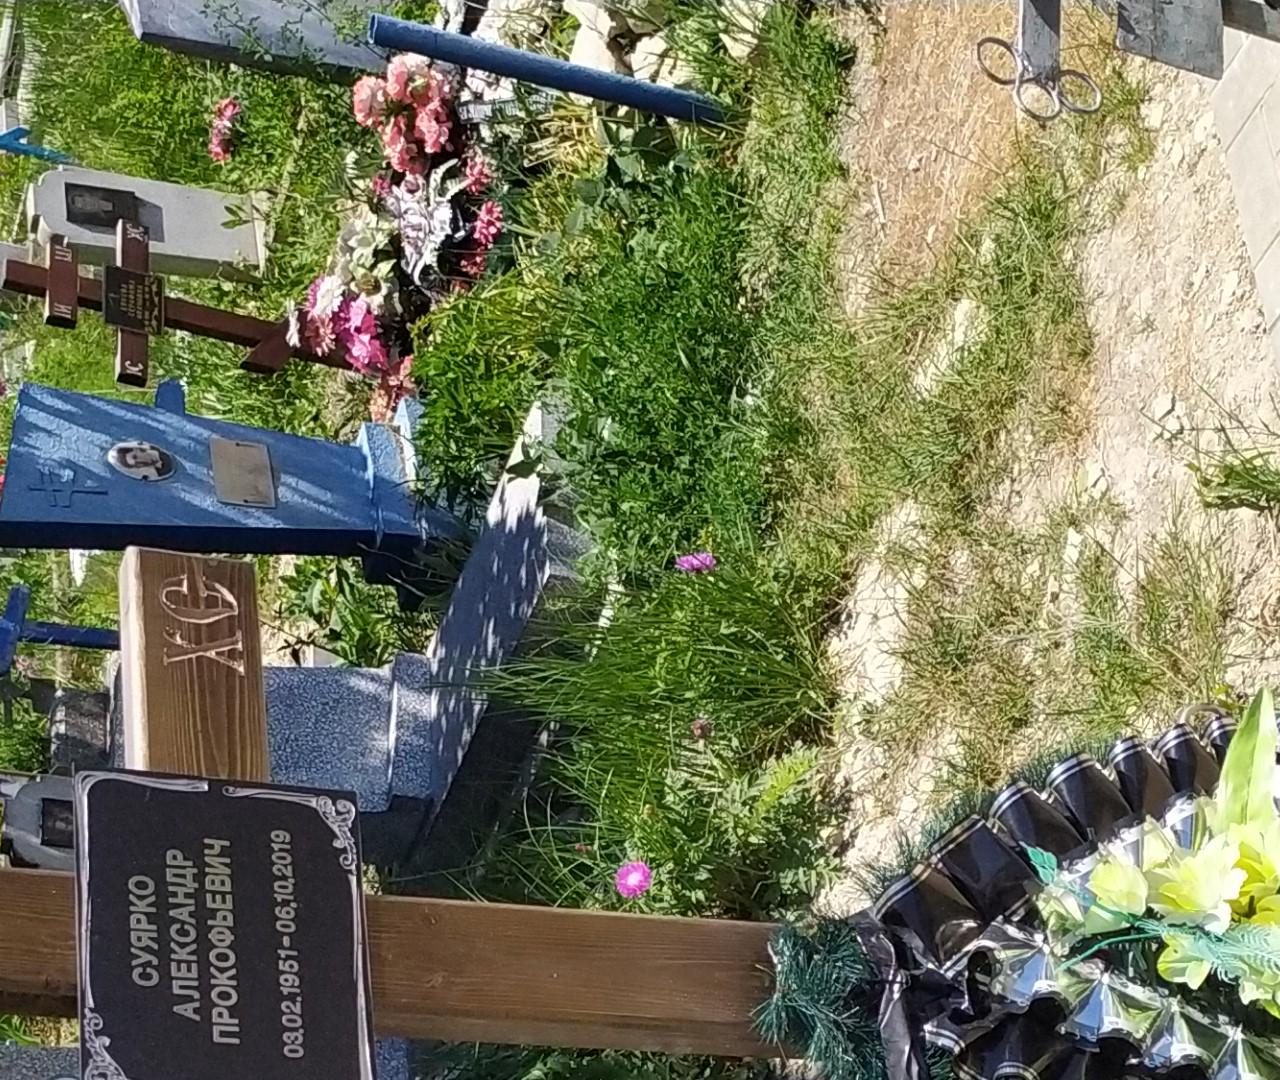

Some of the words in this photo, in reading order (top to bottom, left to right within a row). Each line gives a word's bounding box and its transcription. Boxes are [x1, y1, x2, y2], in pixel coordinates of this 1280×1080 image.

[128, 874, 160, 987] СУЯРКО
[166, 849, 201, 1022] АЛЕКСАНДР
[203, 837, 241, 1045] ПРОКОФЬЕВИЧ
